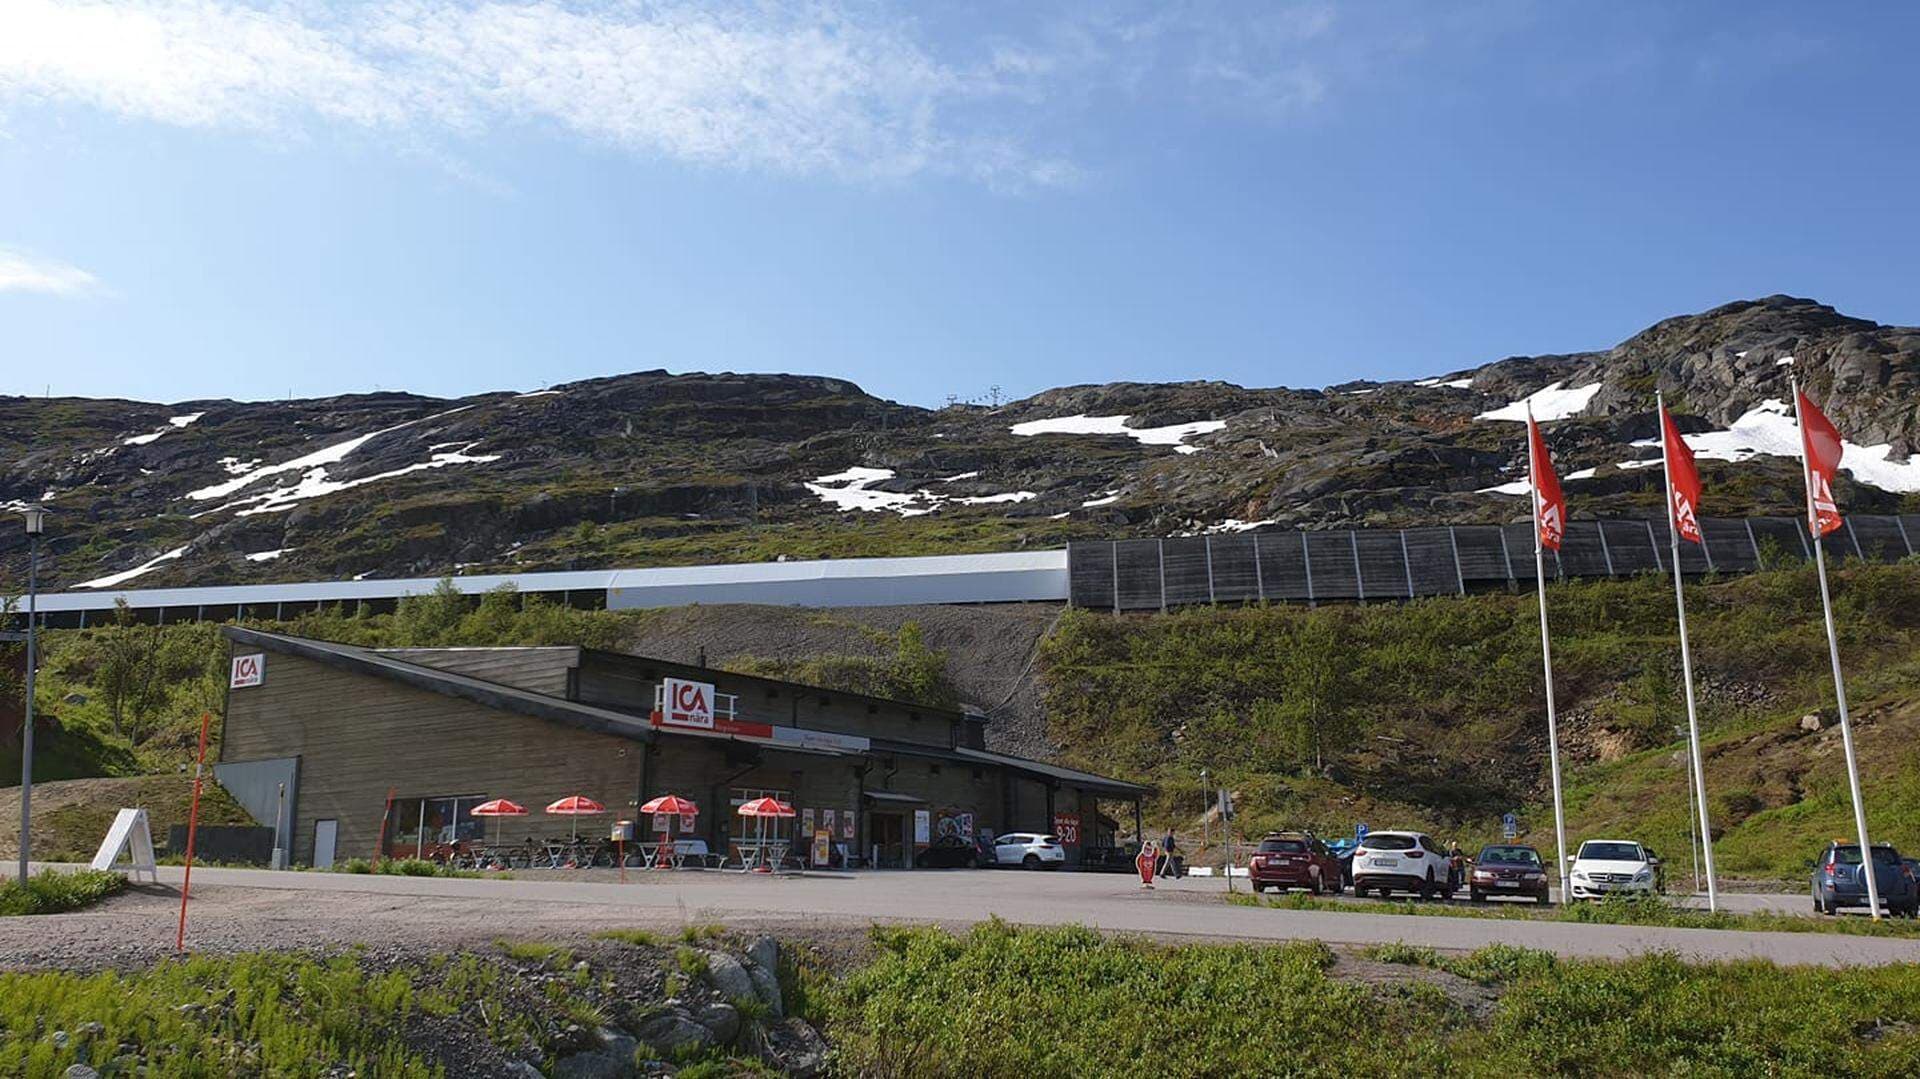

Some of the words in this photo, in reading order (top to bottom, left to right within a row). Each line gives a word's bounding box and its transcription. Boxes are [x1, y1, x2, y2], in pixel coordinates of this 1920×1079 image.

[236, 658, 258, 678] ICA
[672, 683, 709, 714] ICA
[1056, 825, 1077, 842] 9-20
[1358, 825, 1365, 834] P
